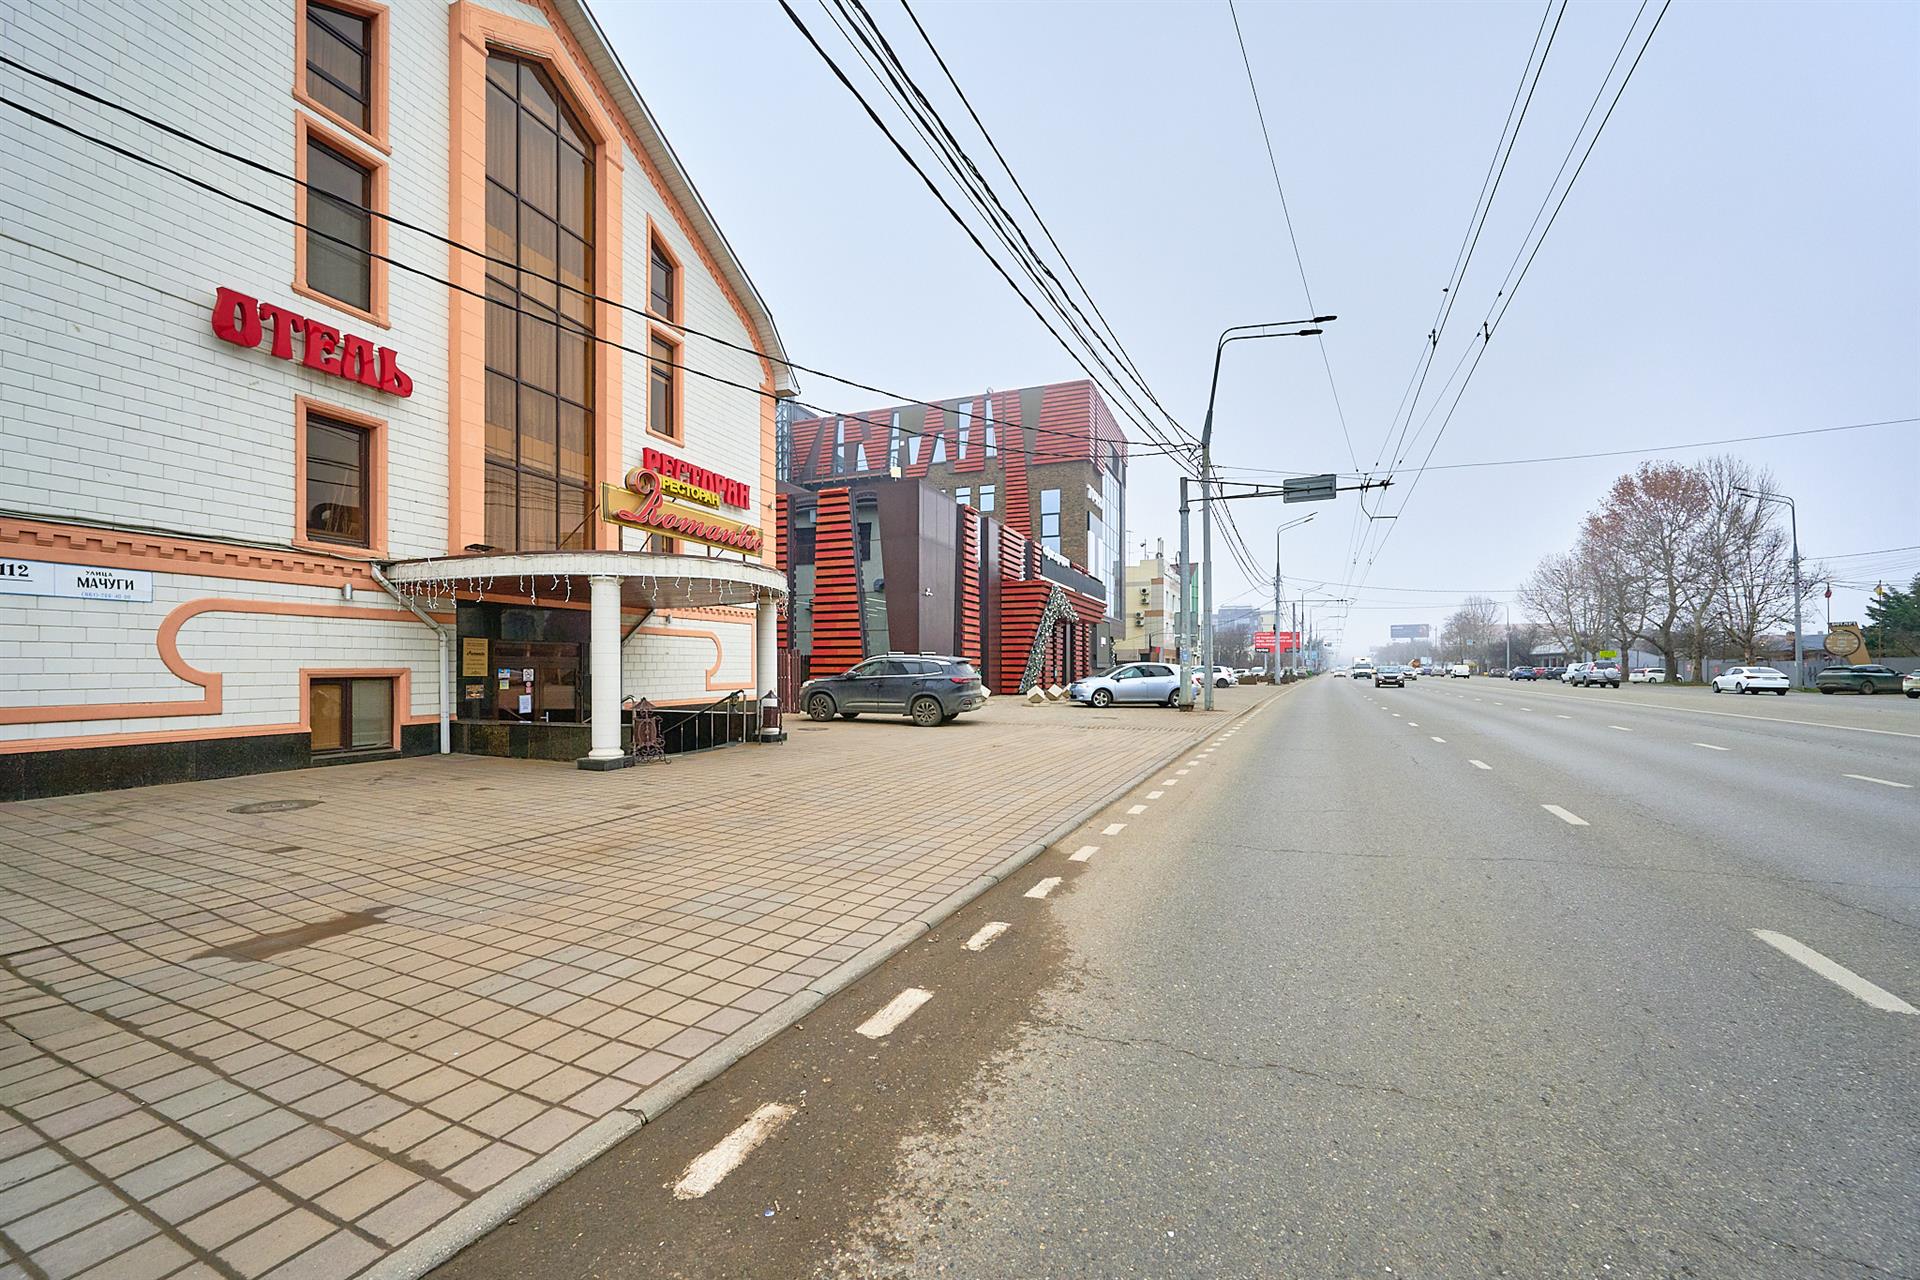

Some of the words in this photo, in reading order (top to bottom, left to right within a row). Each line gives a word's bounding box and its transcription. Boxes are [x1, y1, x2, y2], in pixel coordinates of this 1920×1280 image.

[212, 286, 414, 398] ОТЕЛЬ
[642, 447, 750, 510] РЕСТОРАН
[662, 478, 720, 506] РЕСТОРАН
[617, 469, 764, 551] Romantic
[0, 563, 29, 577] 112
[77, 576, 134, 591] МАЧУГИ
